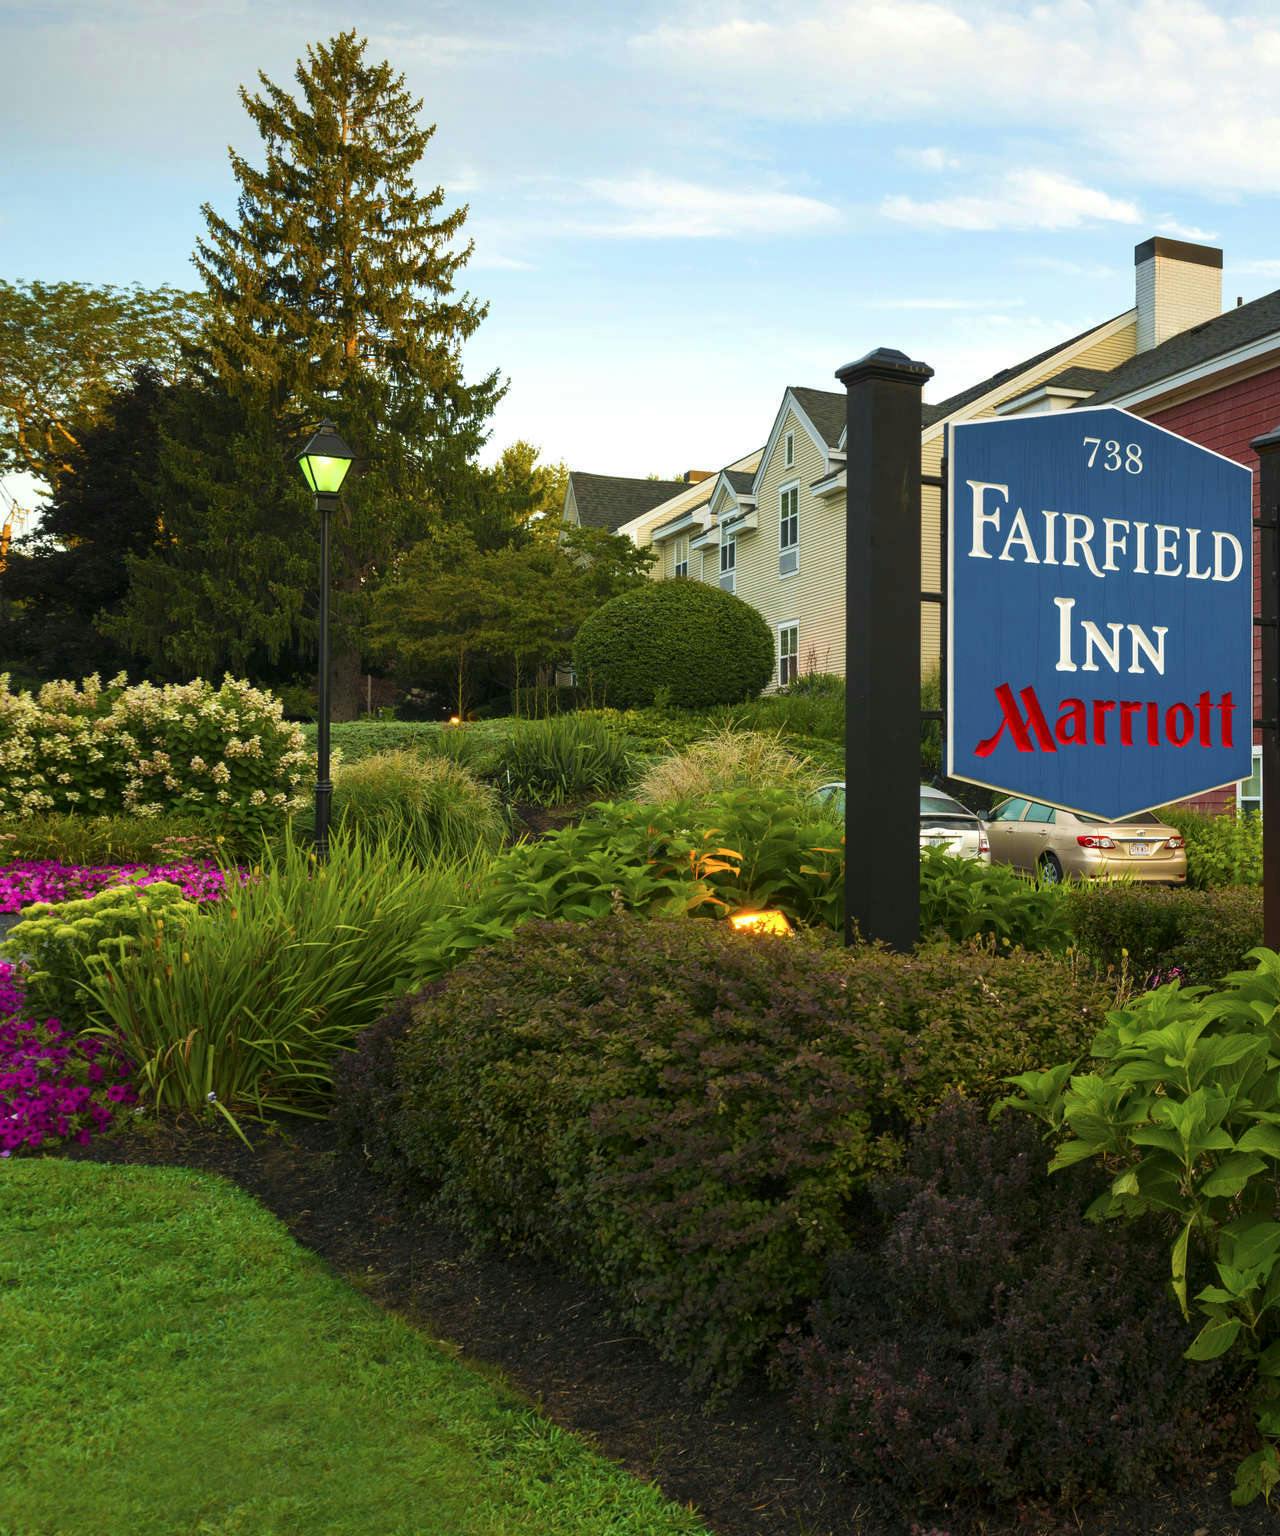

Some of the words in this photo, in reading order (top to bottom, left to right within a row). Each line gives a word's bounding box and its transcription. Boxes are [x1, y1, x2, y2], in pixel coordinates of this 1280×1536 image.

[1083, 437, 1144, 474] 738
[966, 480, 1243, 583] FAIRFIELD
[1053, 596, 1169, 675] INN
[973, 682, 1238, 758] Marriott
